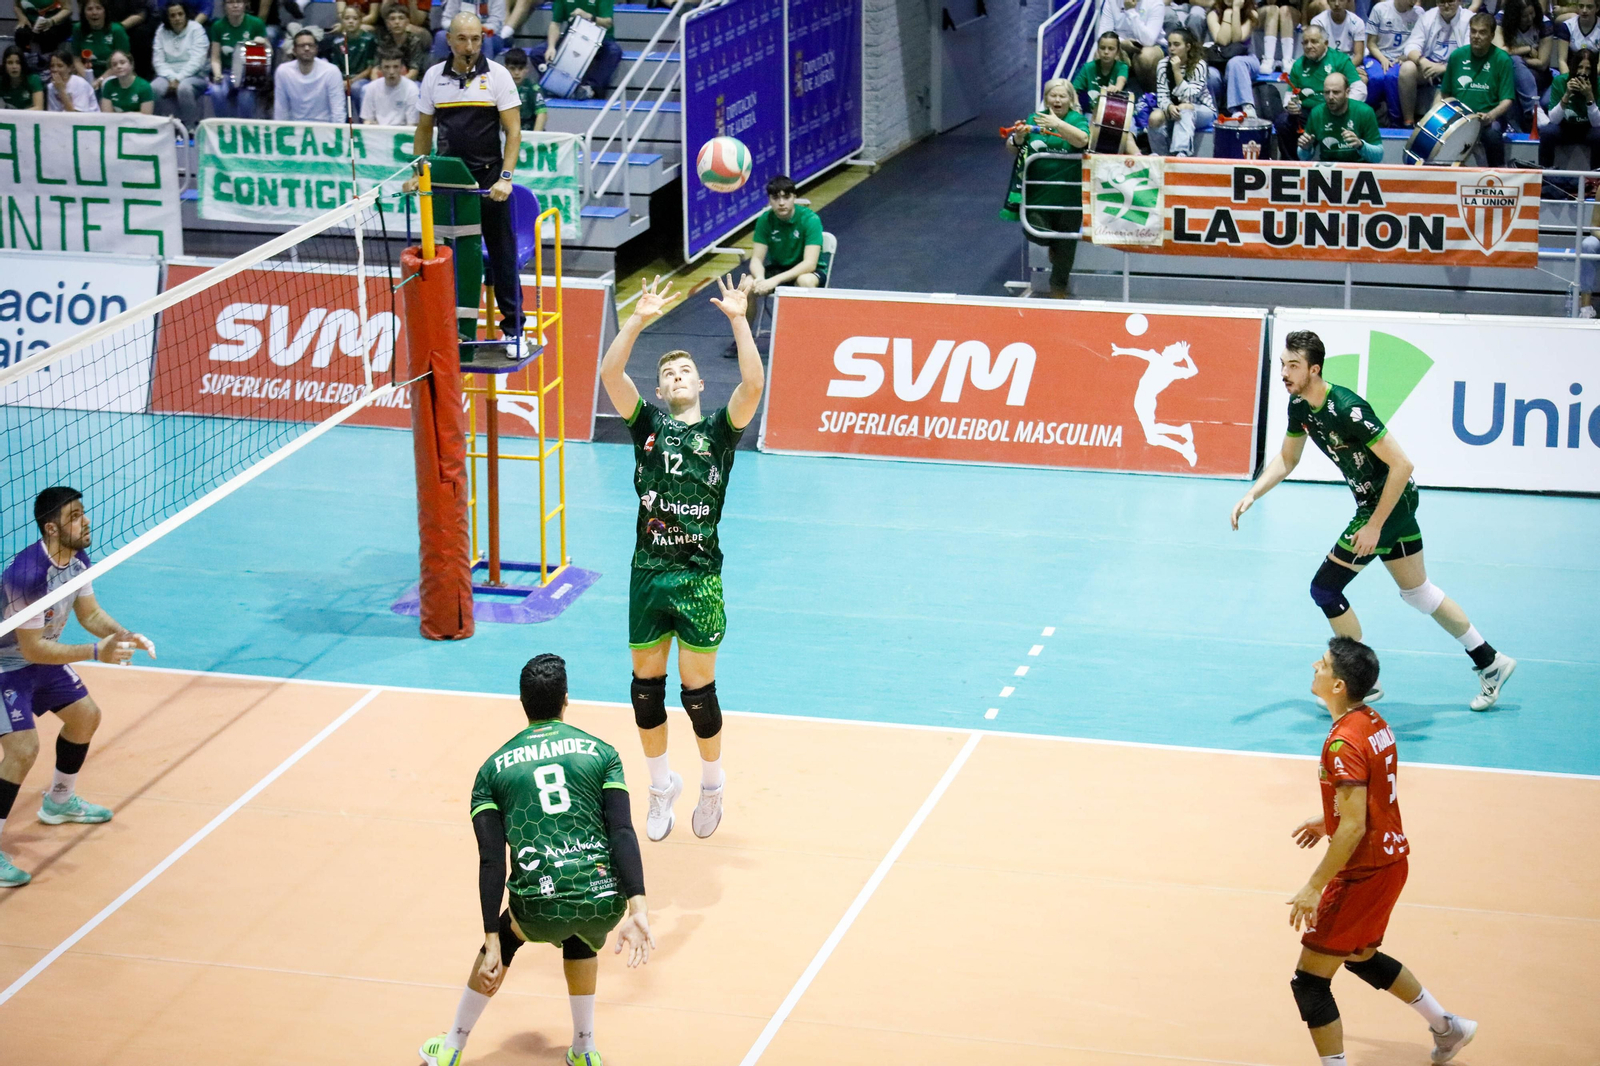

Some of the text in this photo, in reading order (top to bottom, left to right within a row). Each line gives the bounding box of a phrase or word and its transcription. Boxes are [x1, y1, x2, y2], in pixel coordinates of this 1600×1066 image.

[1464, 197, 1515, 207] LA UNION
[1173, 207, 1445, 250] LA UNION
[209, 302, 401, 373] SVM
[199, 372, 291, 401] SUPERLIGA
[826, 336, 1037, 407] SVM
[818, 410, 1123, 448] SUPERLIGA VOLEIBOL MASCULINA
[662, 451, 683, 476] 12
[660, 499, 710, 520] Unicaja
[494, 738, 599, 774] FERNÁNDEZ
[533, 763, 572, 815] 8
